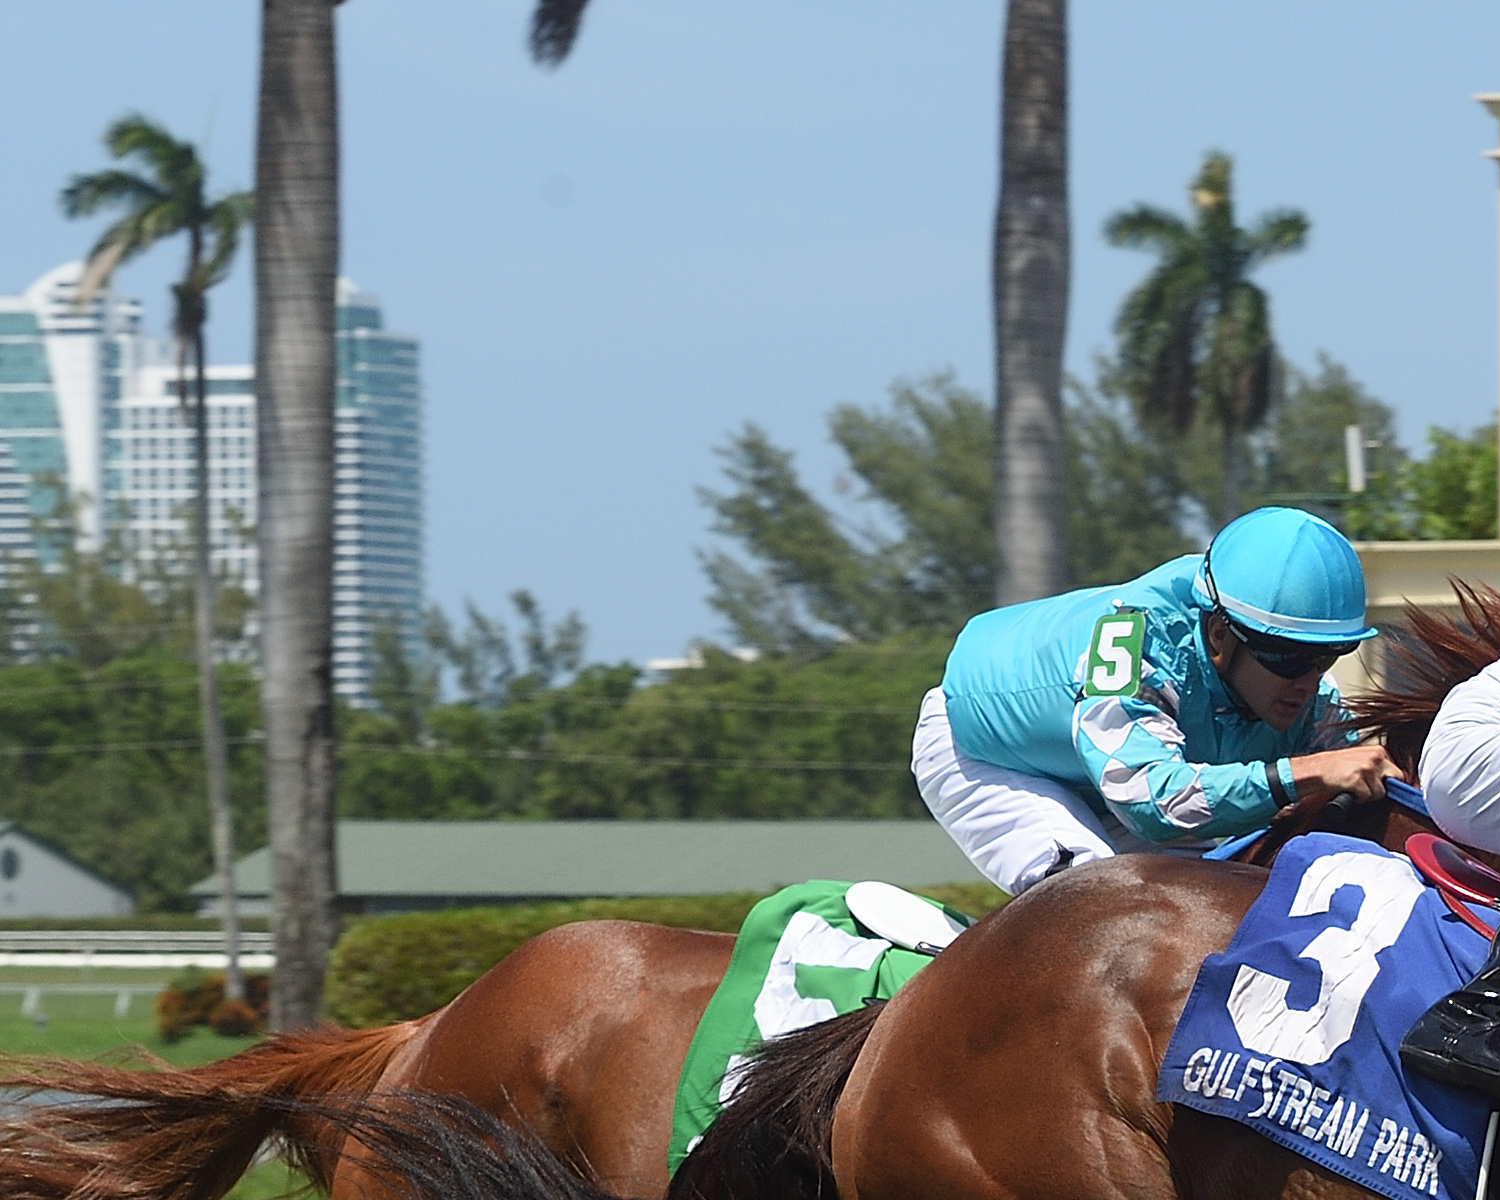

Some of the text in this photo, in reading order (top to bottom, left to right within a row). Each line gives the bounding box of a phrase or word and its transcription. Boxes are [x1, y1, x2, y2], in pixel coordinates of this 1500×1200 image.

[1092, 621, 1134, 691] 5
[1226, 851, 1426, 1066] 3
[1182, 1047, 1443, 1195] GULFSTREAM PARK
